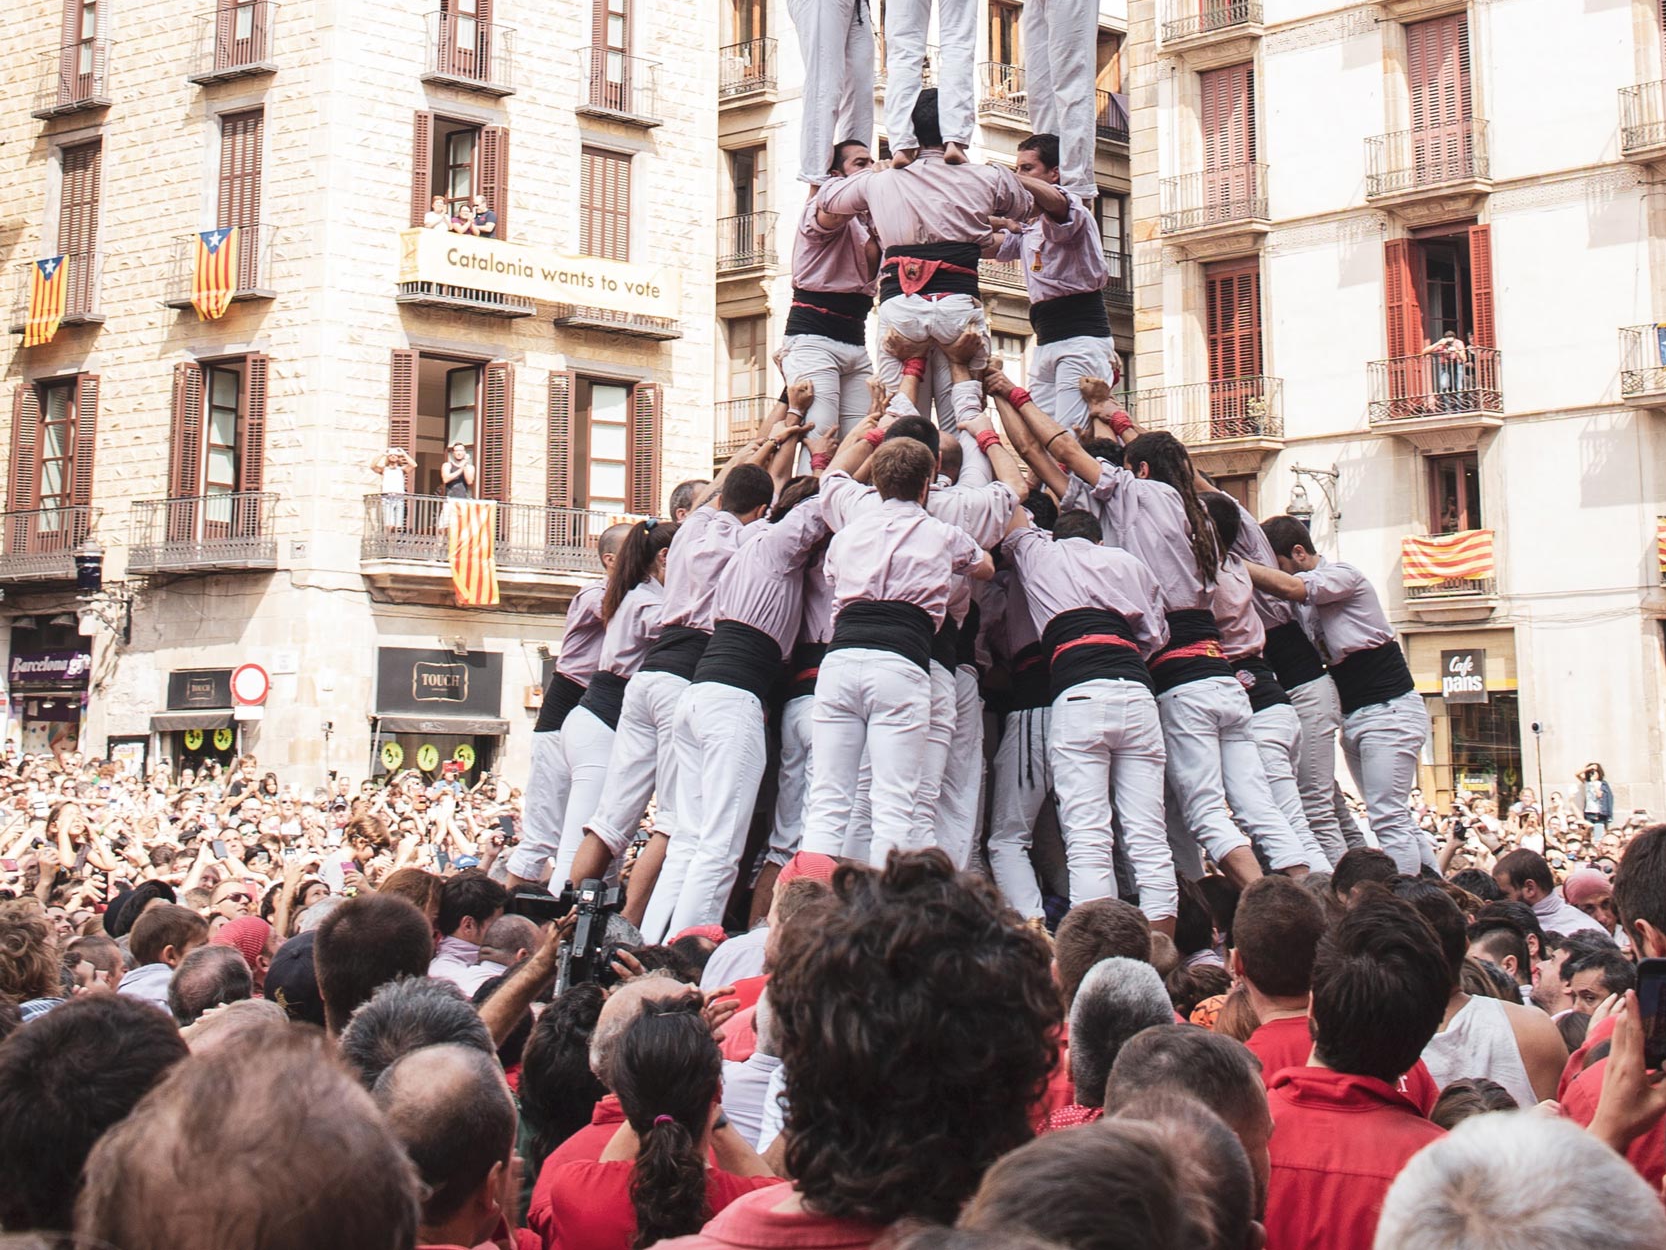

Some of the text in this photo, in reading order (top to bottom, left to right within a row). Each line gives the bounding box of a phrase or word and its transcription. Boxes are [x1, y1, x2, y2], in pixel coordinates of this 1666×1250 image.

[447, 248, 660, 298] Catalonia wants to vote
[12, 656, 68, 672] Barcelona
[421, 674, 460, 686] TOUCH
[1442, 676, 1483, 697] pans
